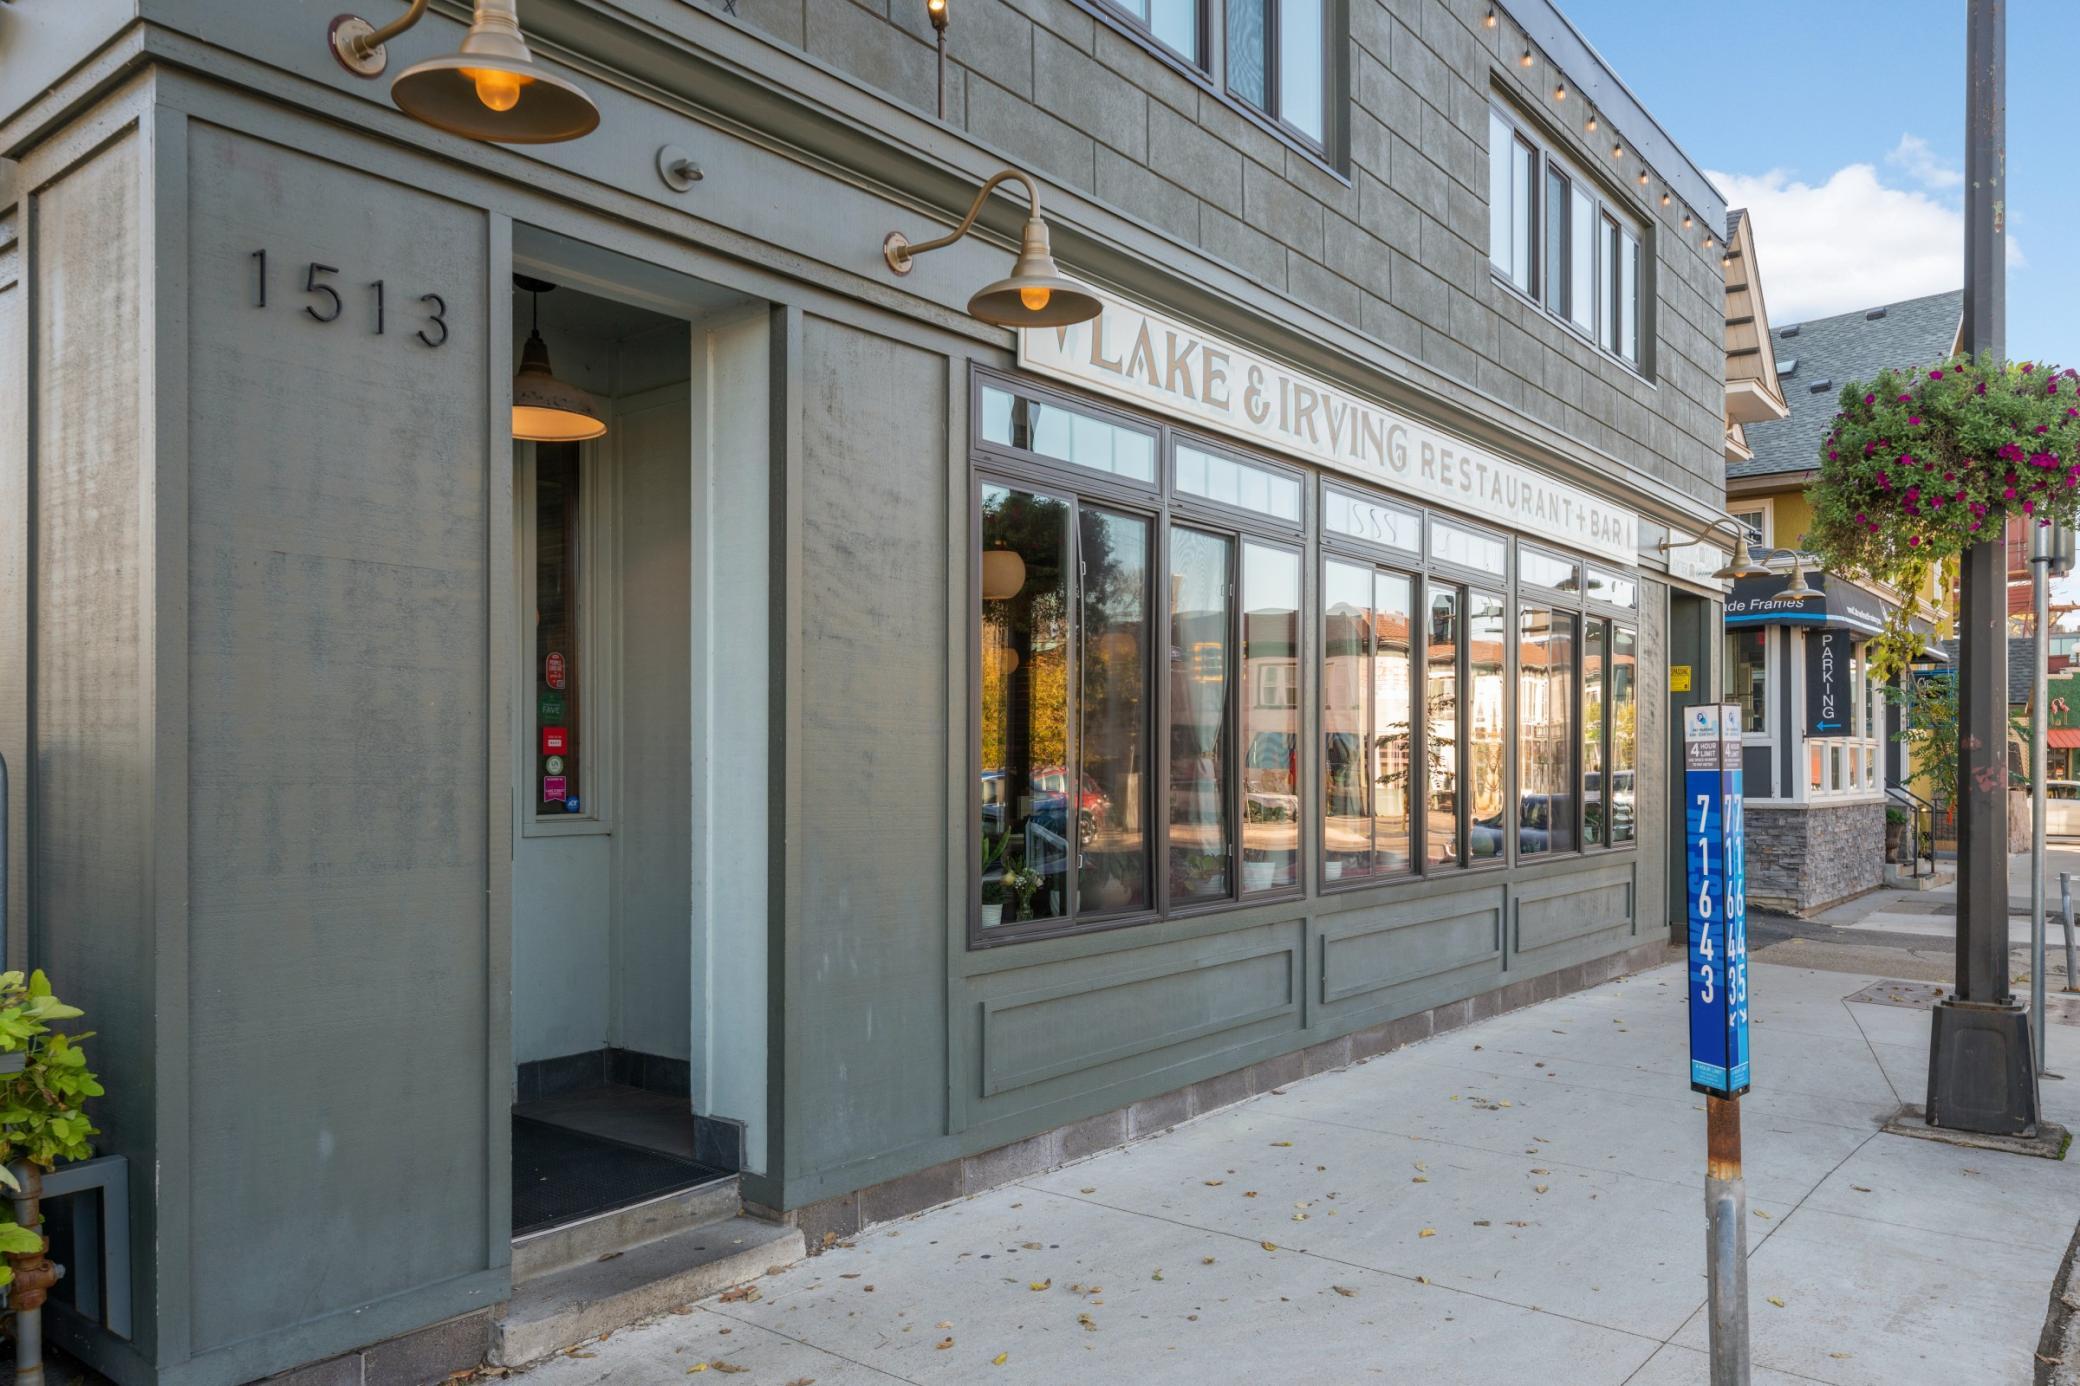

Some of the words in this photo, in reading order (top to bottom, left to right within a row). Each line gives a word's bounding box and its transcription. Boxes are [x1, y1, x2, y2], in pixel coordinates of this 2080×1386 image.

[251, 248, 449, 348] 1513
[1089, 312, 1230, 412] LAKE
[1243, 364, 1271, 425] &
[1278, 376, 1408, 473] IRVING
[1421, 440, 1572, 528] RESTAURANT
[1590, 509, 1622, 546] BAR
[1749, 598, 1804, 611] Frames
[1821, 634, 1835, 719] PARKING
[1691, 742, 1700, 757] 4
[1697, 795, 1714, 1004] 71643
[1724, 795, 1737, 1005] 71643
[1733, 794, 1746, 1003] 71645
